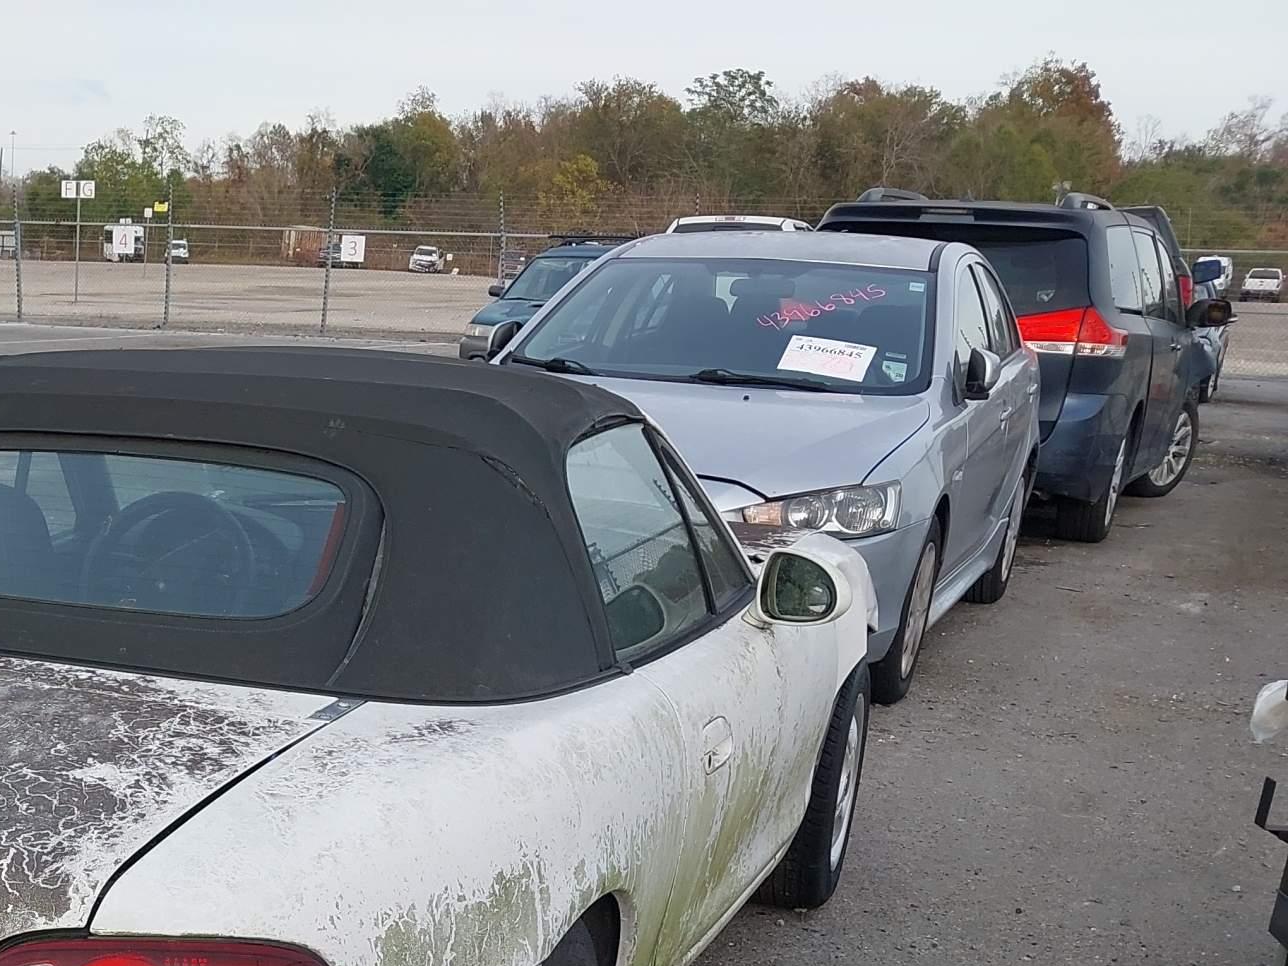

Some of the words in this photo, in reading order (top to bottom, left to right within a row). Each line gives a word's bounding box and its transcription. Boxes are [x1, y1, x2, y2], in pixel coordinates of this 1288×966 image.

[65, 181, 73, 197] F
[82, 181, 93, 197] G
[119, 233, 128, 249] 4
[347, 240, 358, 256] 3
[757, 284, 887, 331] 43966845
[796, 343, 864, 359] 43966845
